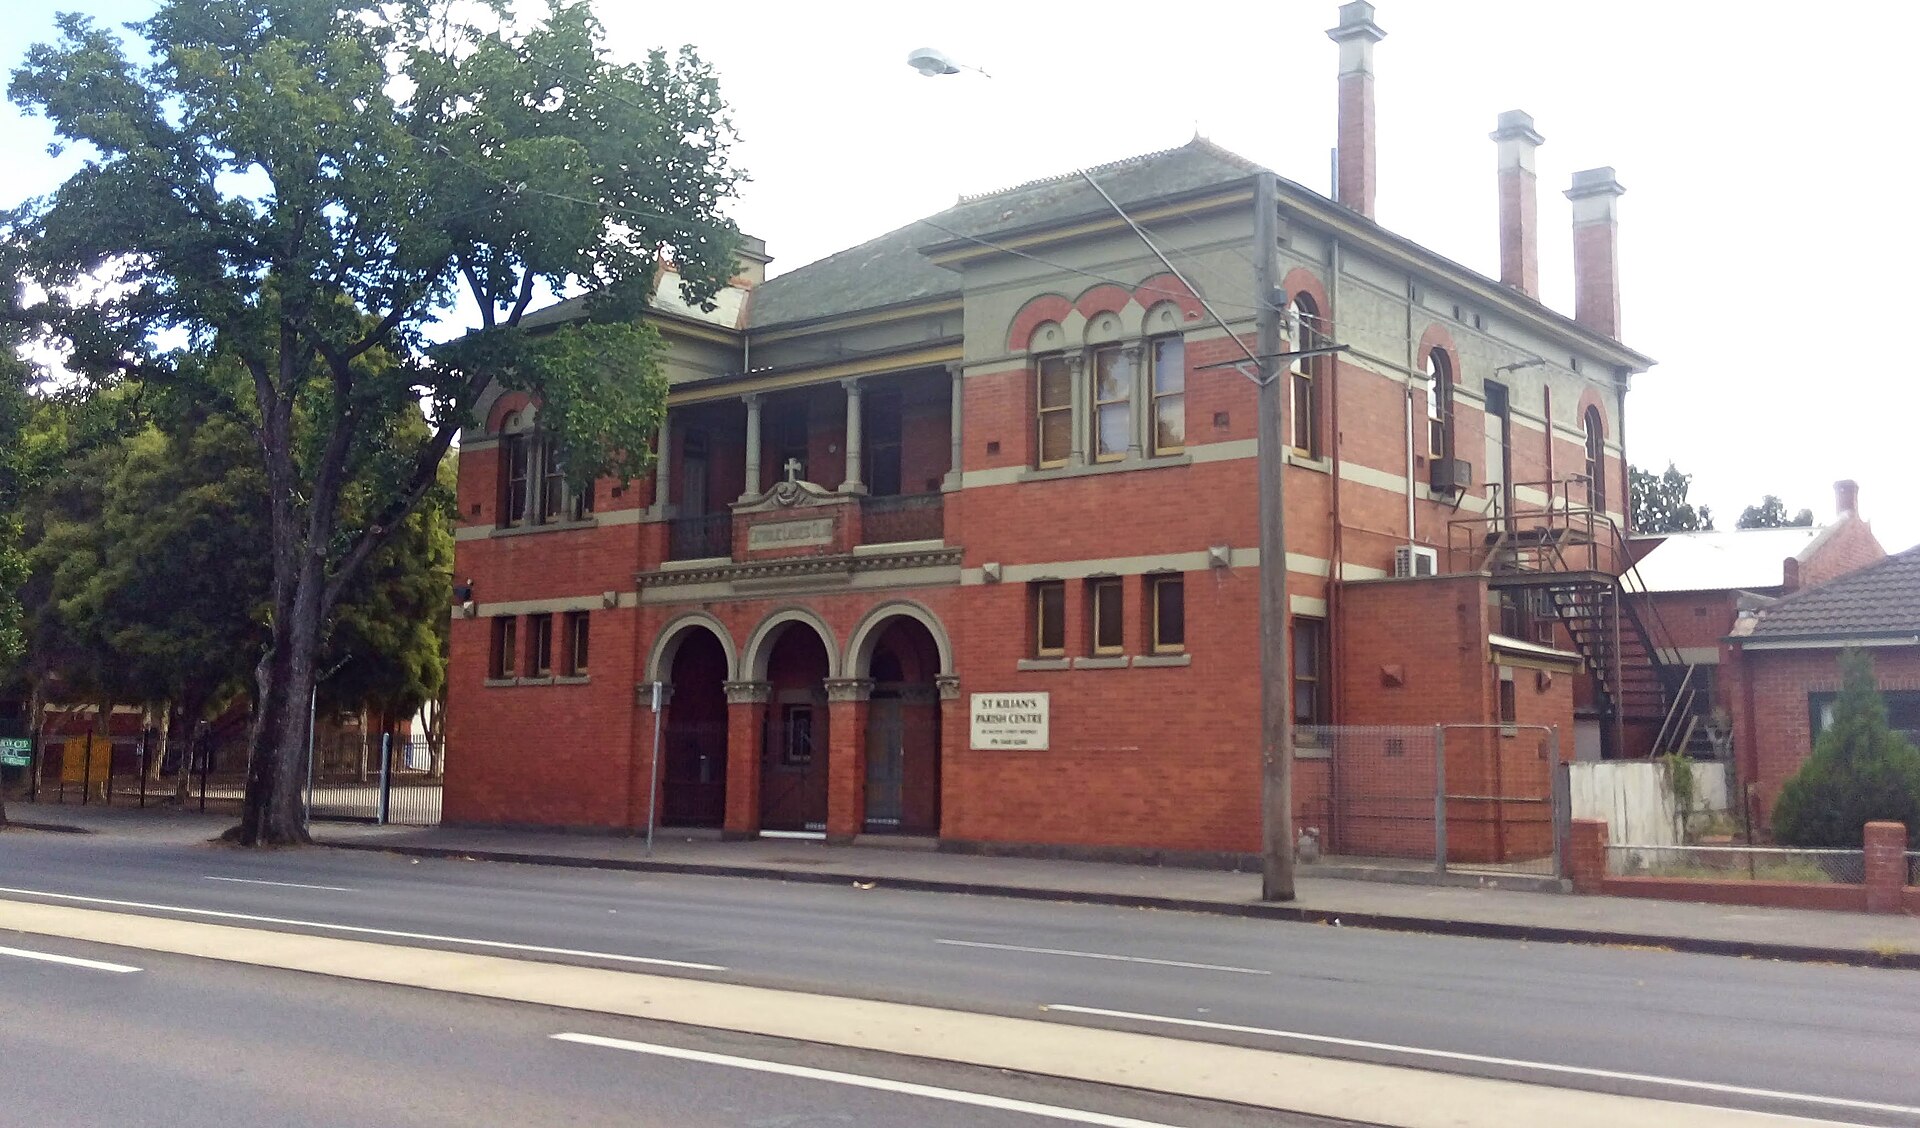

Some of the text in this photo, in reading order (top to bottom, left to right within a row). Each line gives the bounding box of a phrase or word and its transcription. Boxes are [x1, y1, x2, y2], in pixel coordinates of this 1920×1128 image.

[982, 699, 992, 709] ST
[976, 713, 1042, 724] PARISH CENTRE
